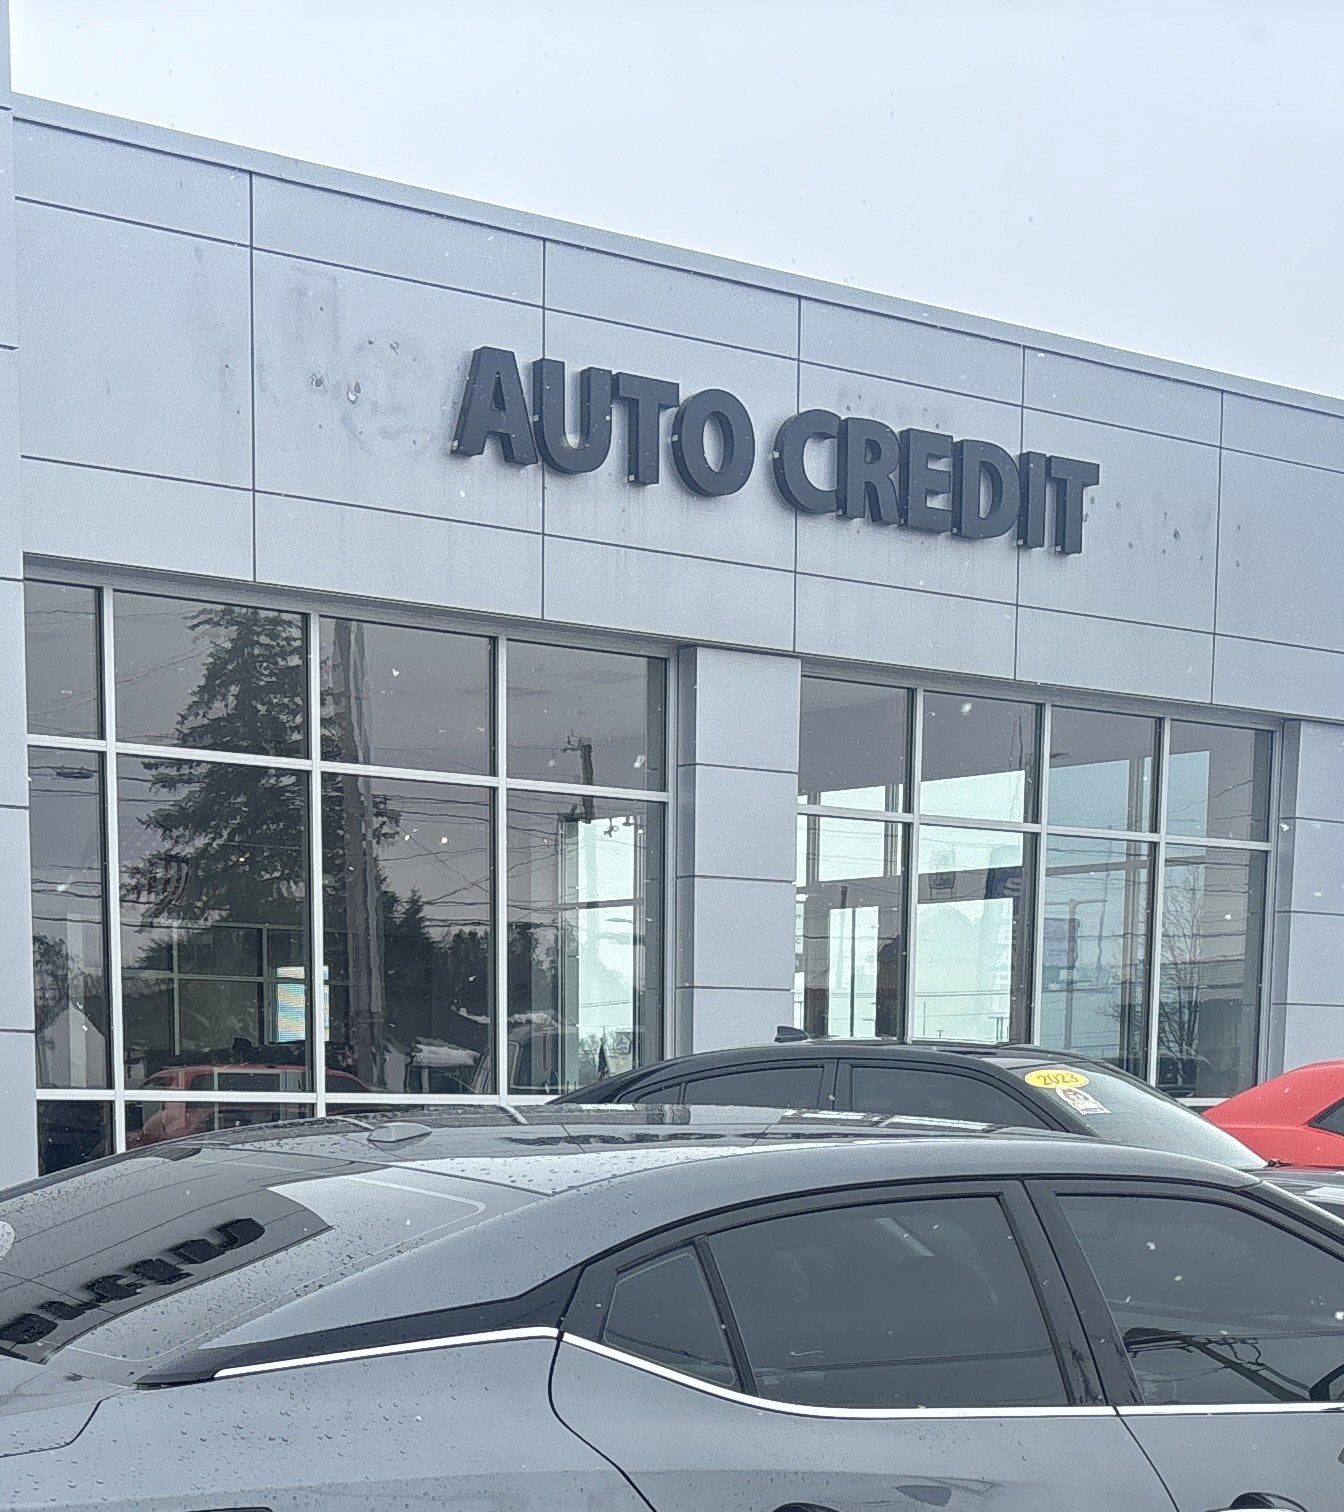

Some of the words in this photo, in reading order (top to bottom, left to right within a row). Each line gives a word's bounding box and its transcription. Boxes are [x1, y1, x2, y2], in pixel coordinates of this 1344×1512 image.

[451, 345, 756, 497] AUTO
[772, 408, 1101, 555] CREDIT
[1036, 1073, 1080, 1085] 2023
